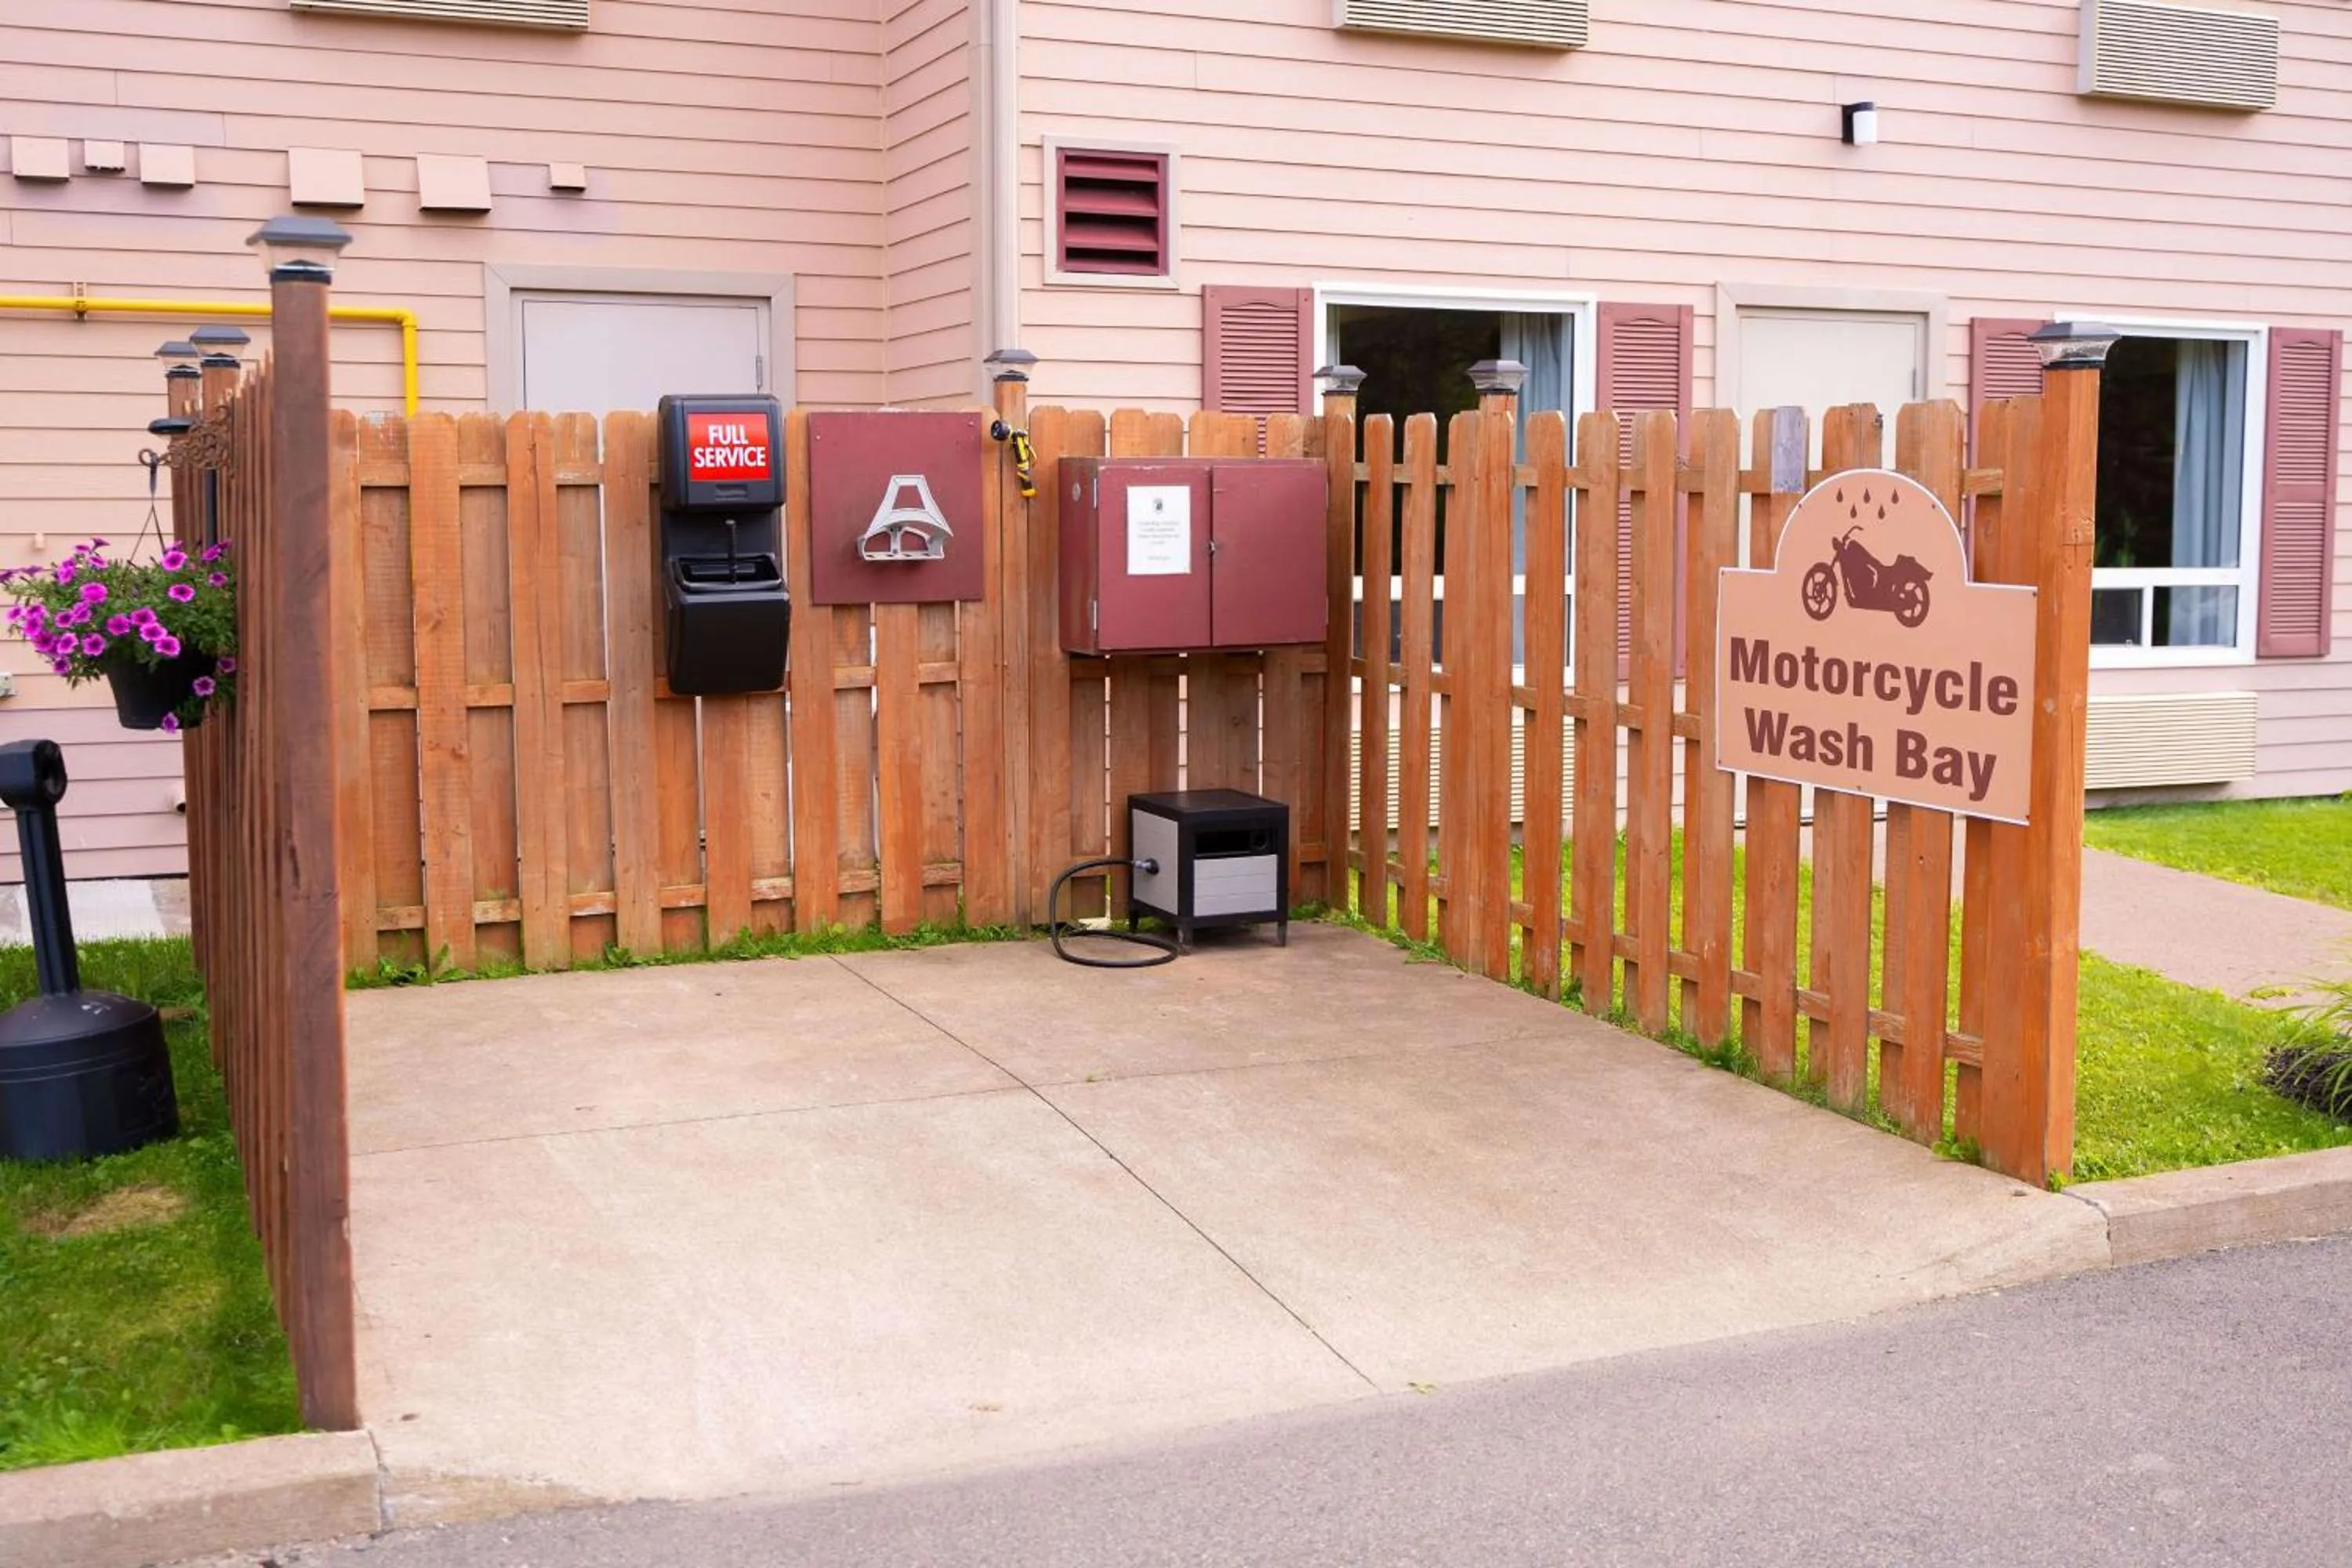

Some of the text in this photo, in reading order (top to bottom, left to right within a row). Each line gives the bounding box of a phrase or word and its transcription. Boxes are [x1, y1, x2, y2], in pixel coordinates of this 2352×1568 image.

[694, 446, 766, 468] SERVICE
[709, 424, 749, 445] FULL
[1730, 636, 2019, 716] Motorcycle
[1744, 706, 1998, 802] Wash Bay
